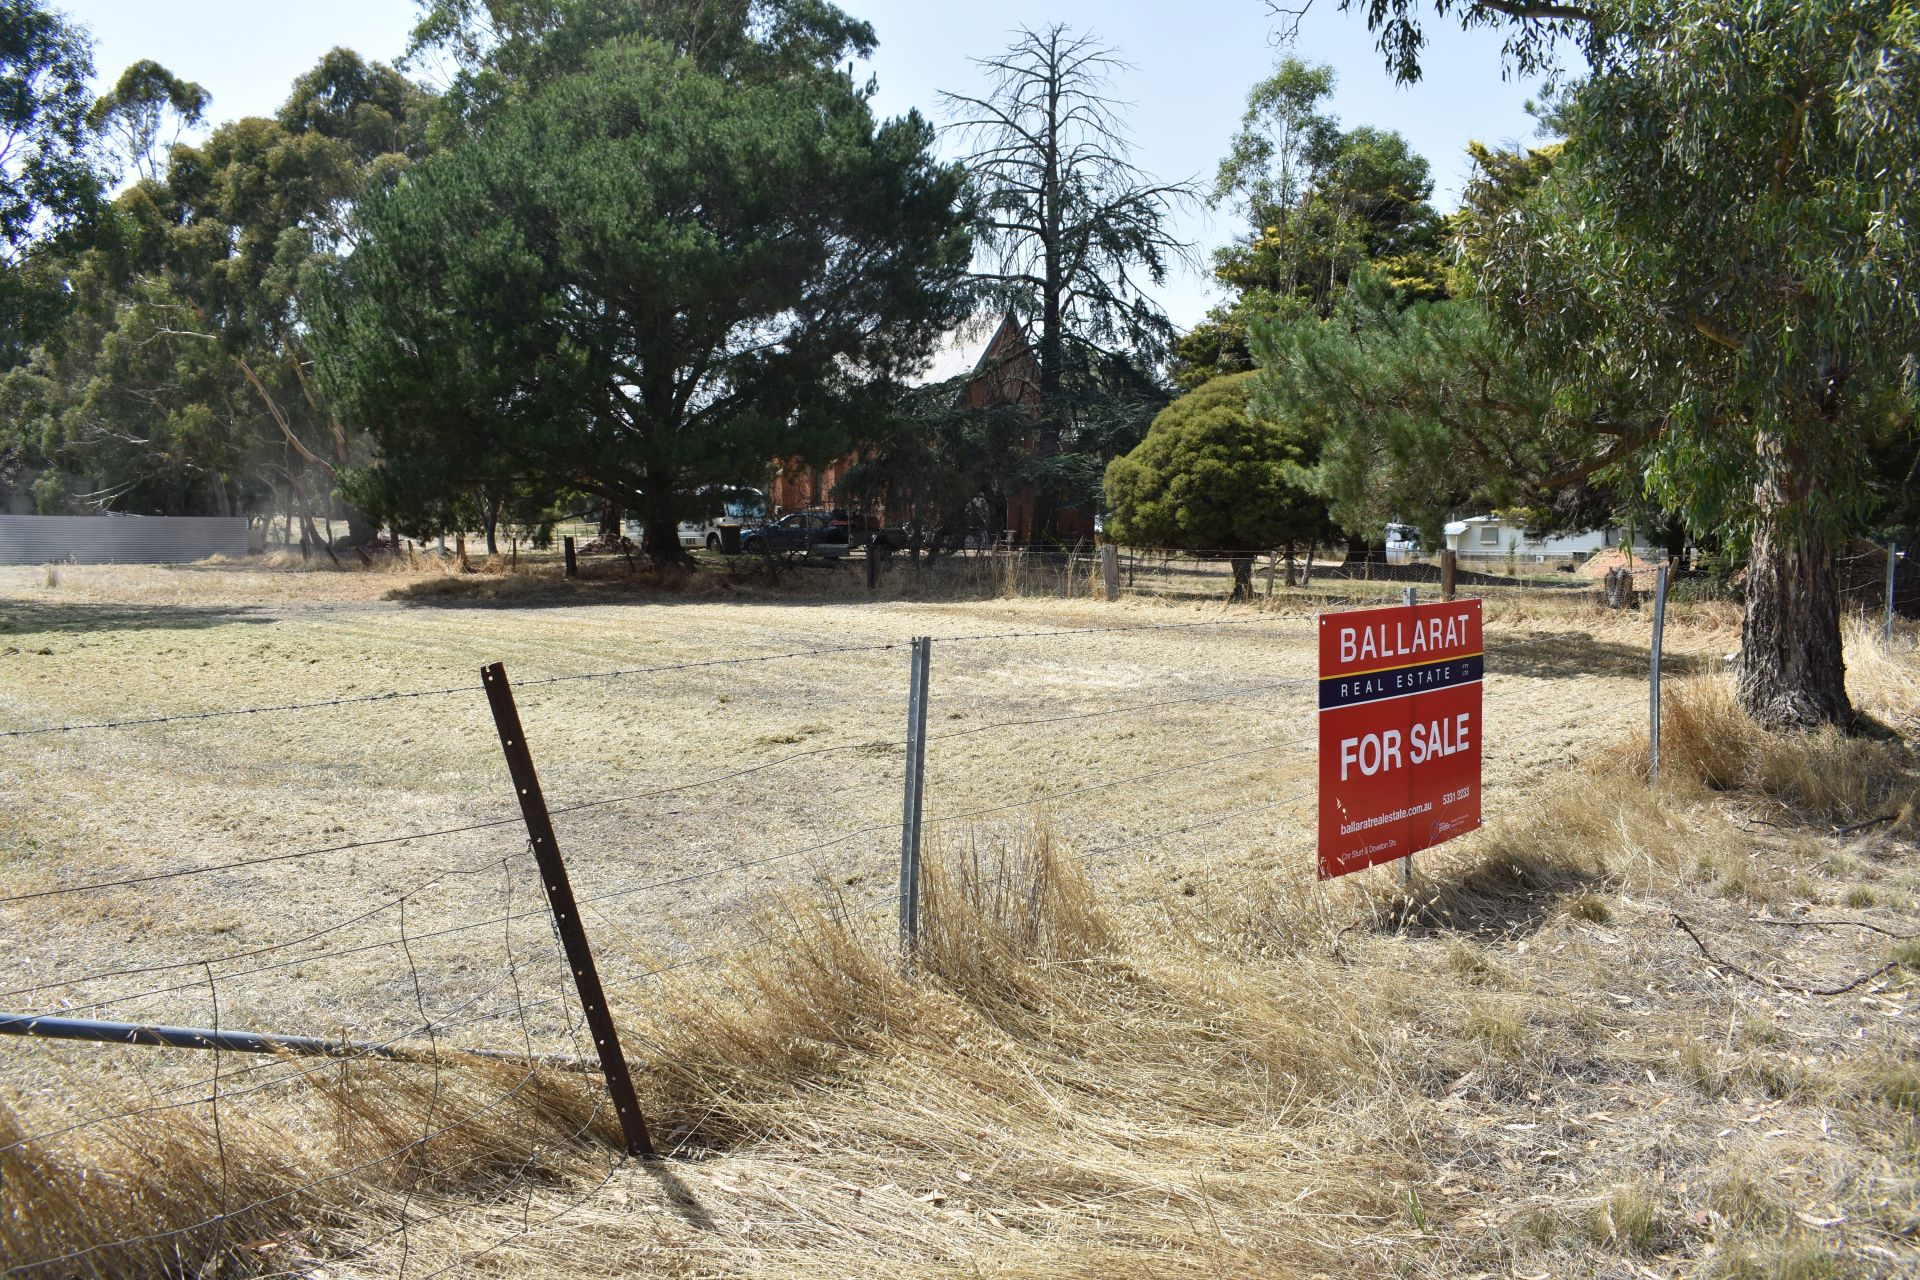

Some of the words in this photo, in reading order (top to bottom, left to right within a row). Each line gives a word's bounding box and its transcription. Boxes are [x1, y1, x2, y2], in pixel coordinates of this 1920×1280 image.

[1340, 614, 1469, 663] BALLARAT
[1341, 678, 1384, 698] REAL
[1396, 667, 1450, 688] ESTATE
[1340, 729, 1402, 782] FOR
[1409, 712, 1470, 765] SALE
[1442, 791, 1456, 805] 5331
[1340, 801, 1432, 835] ballaratrealestate.com.au
